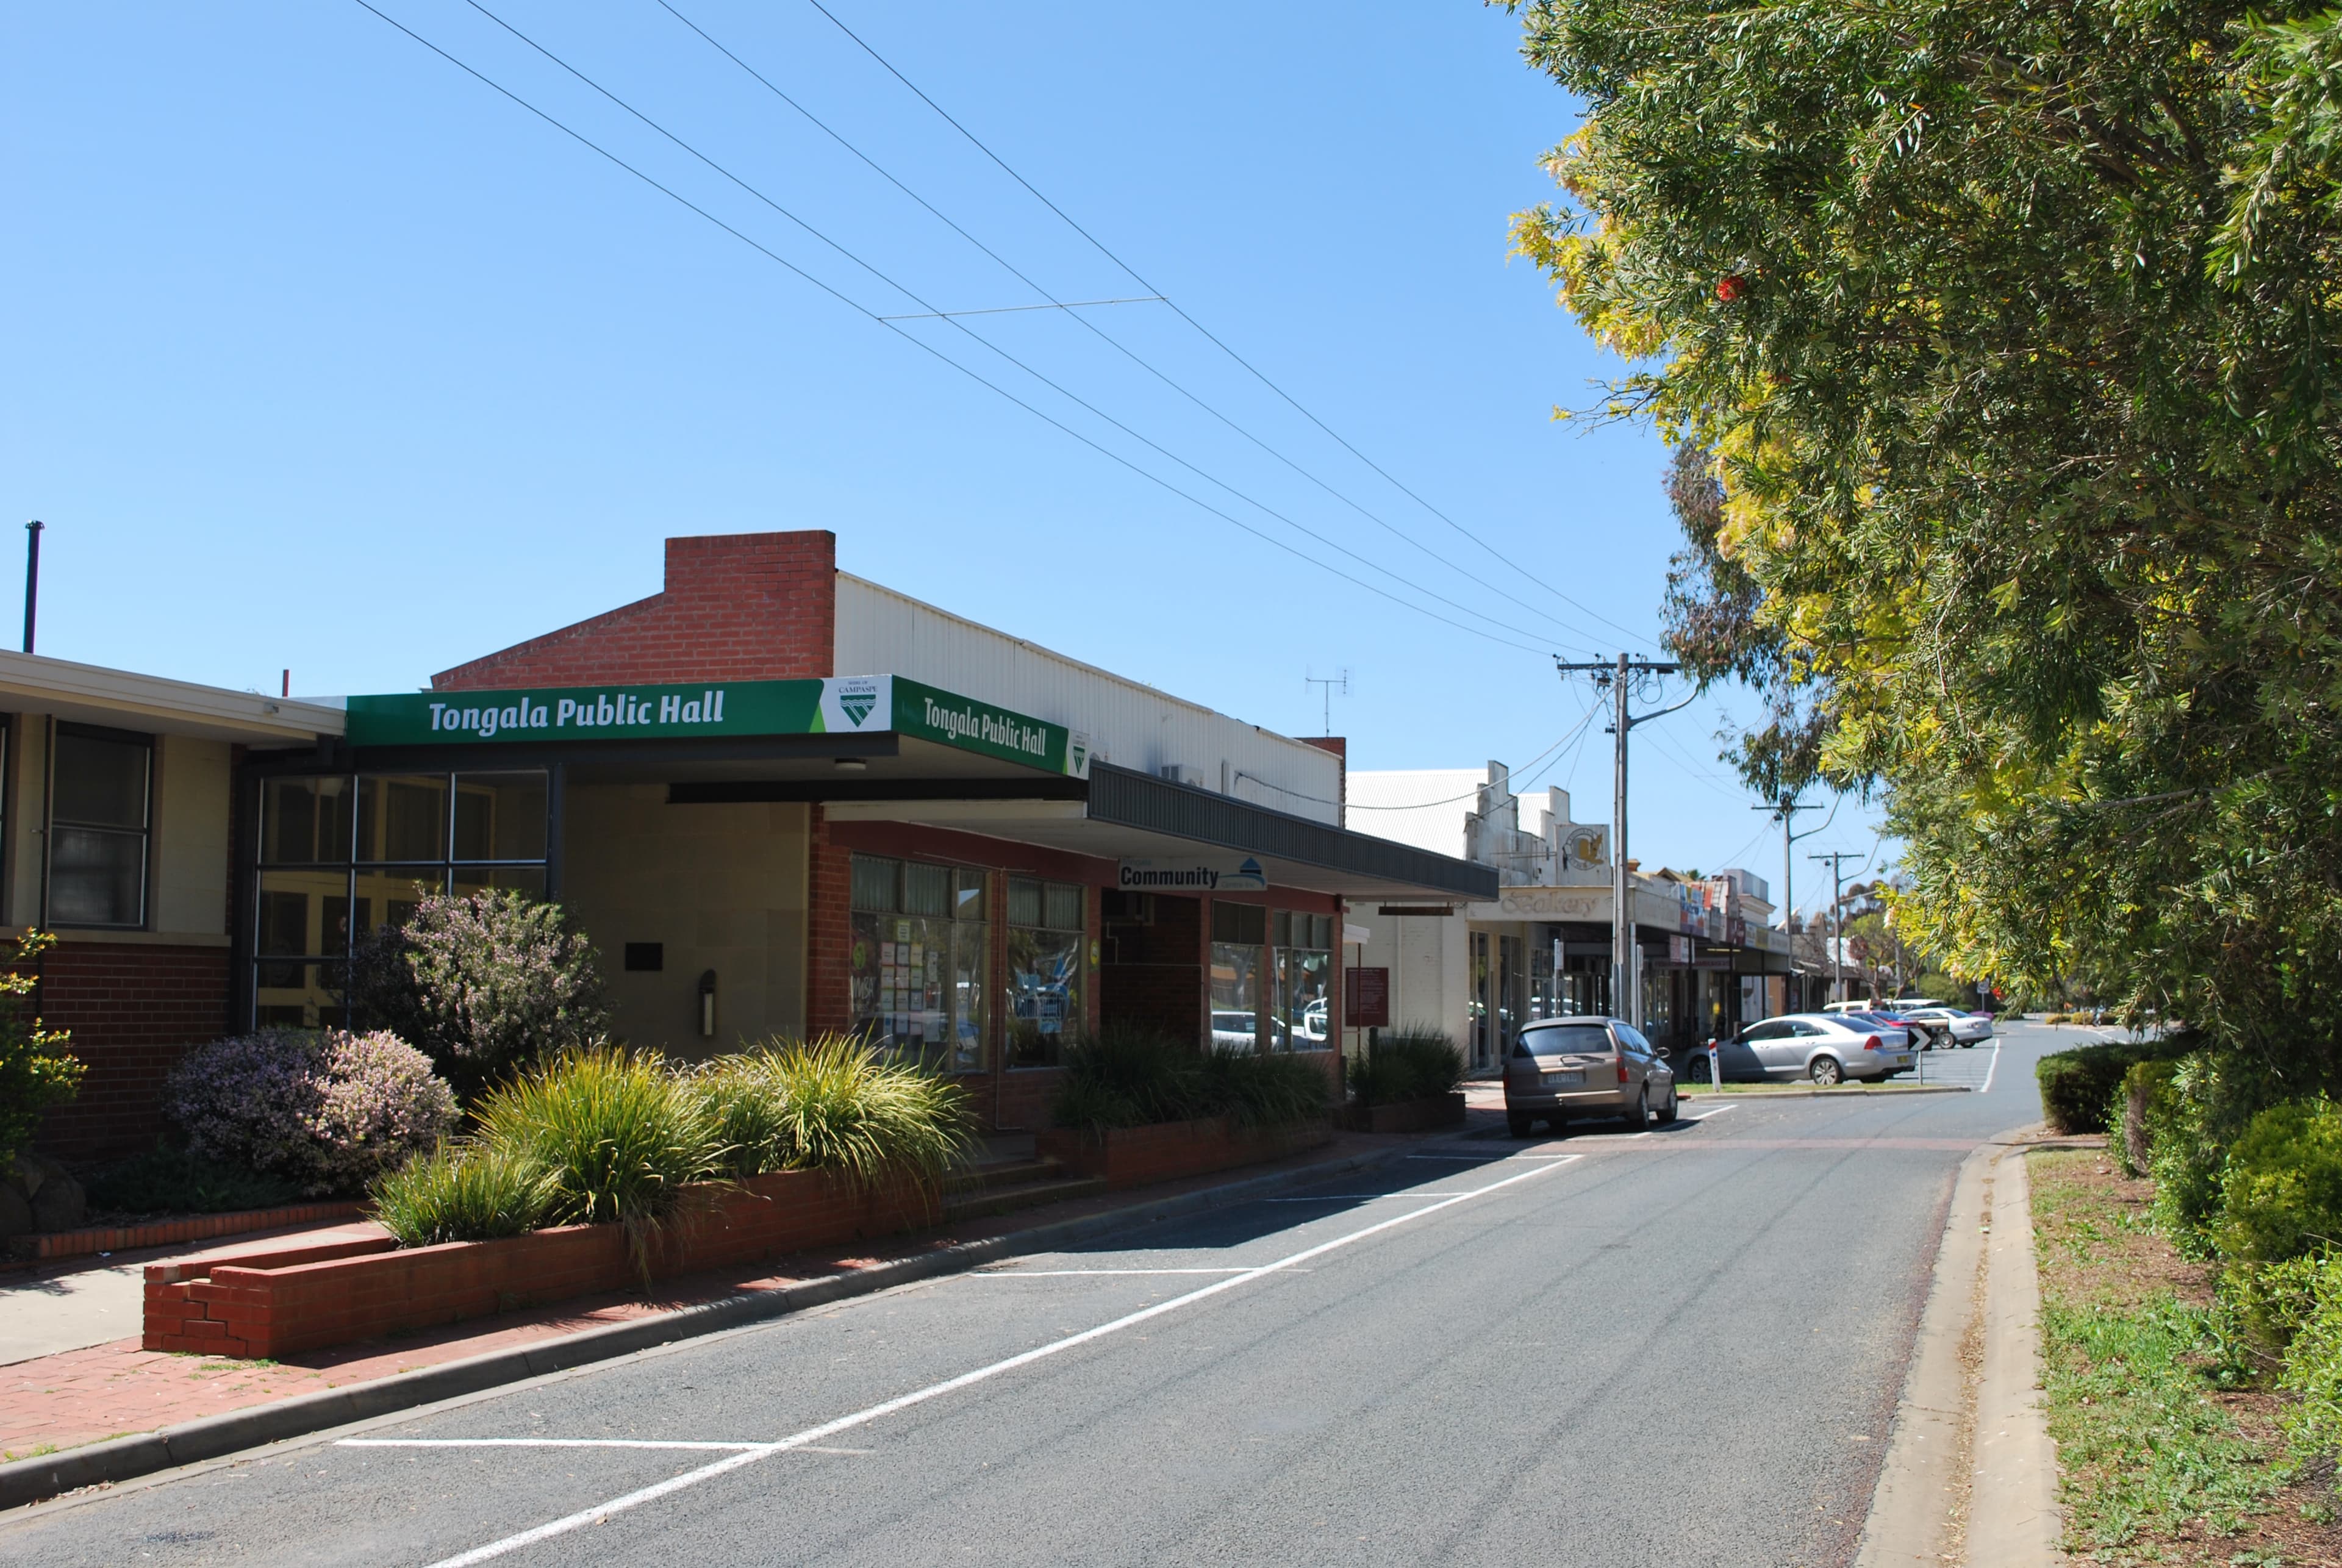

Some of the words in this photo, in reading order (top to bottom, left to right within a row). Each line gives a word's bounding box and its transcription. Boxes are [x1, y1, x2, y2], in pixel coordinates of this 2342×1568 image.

[429, 697, 548, 737] Tongala
[557, 694, 651, 727] Public
[660, 690, 724, 723] Hall
[925, 697, 978, 740] Tongala
[981, 714, 1020, 750] Public
[1022, 725, 1046, 757] Hall
[1121, 867, 1219, 889] Community
[1502, 891, 1599, 917] Bakery
